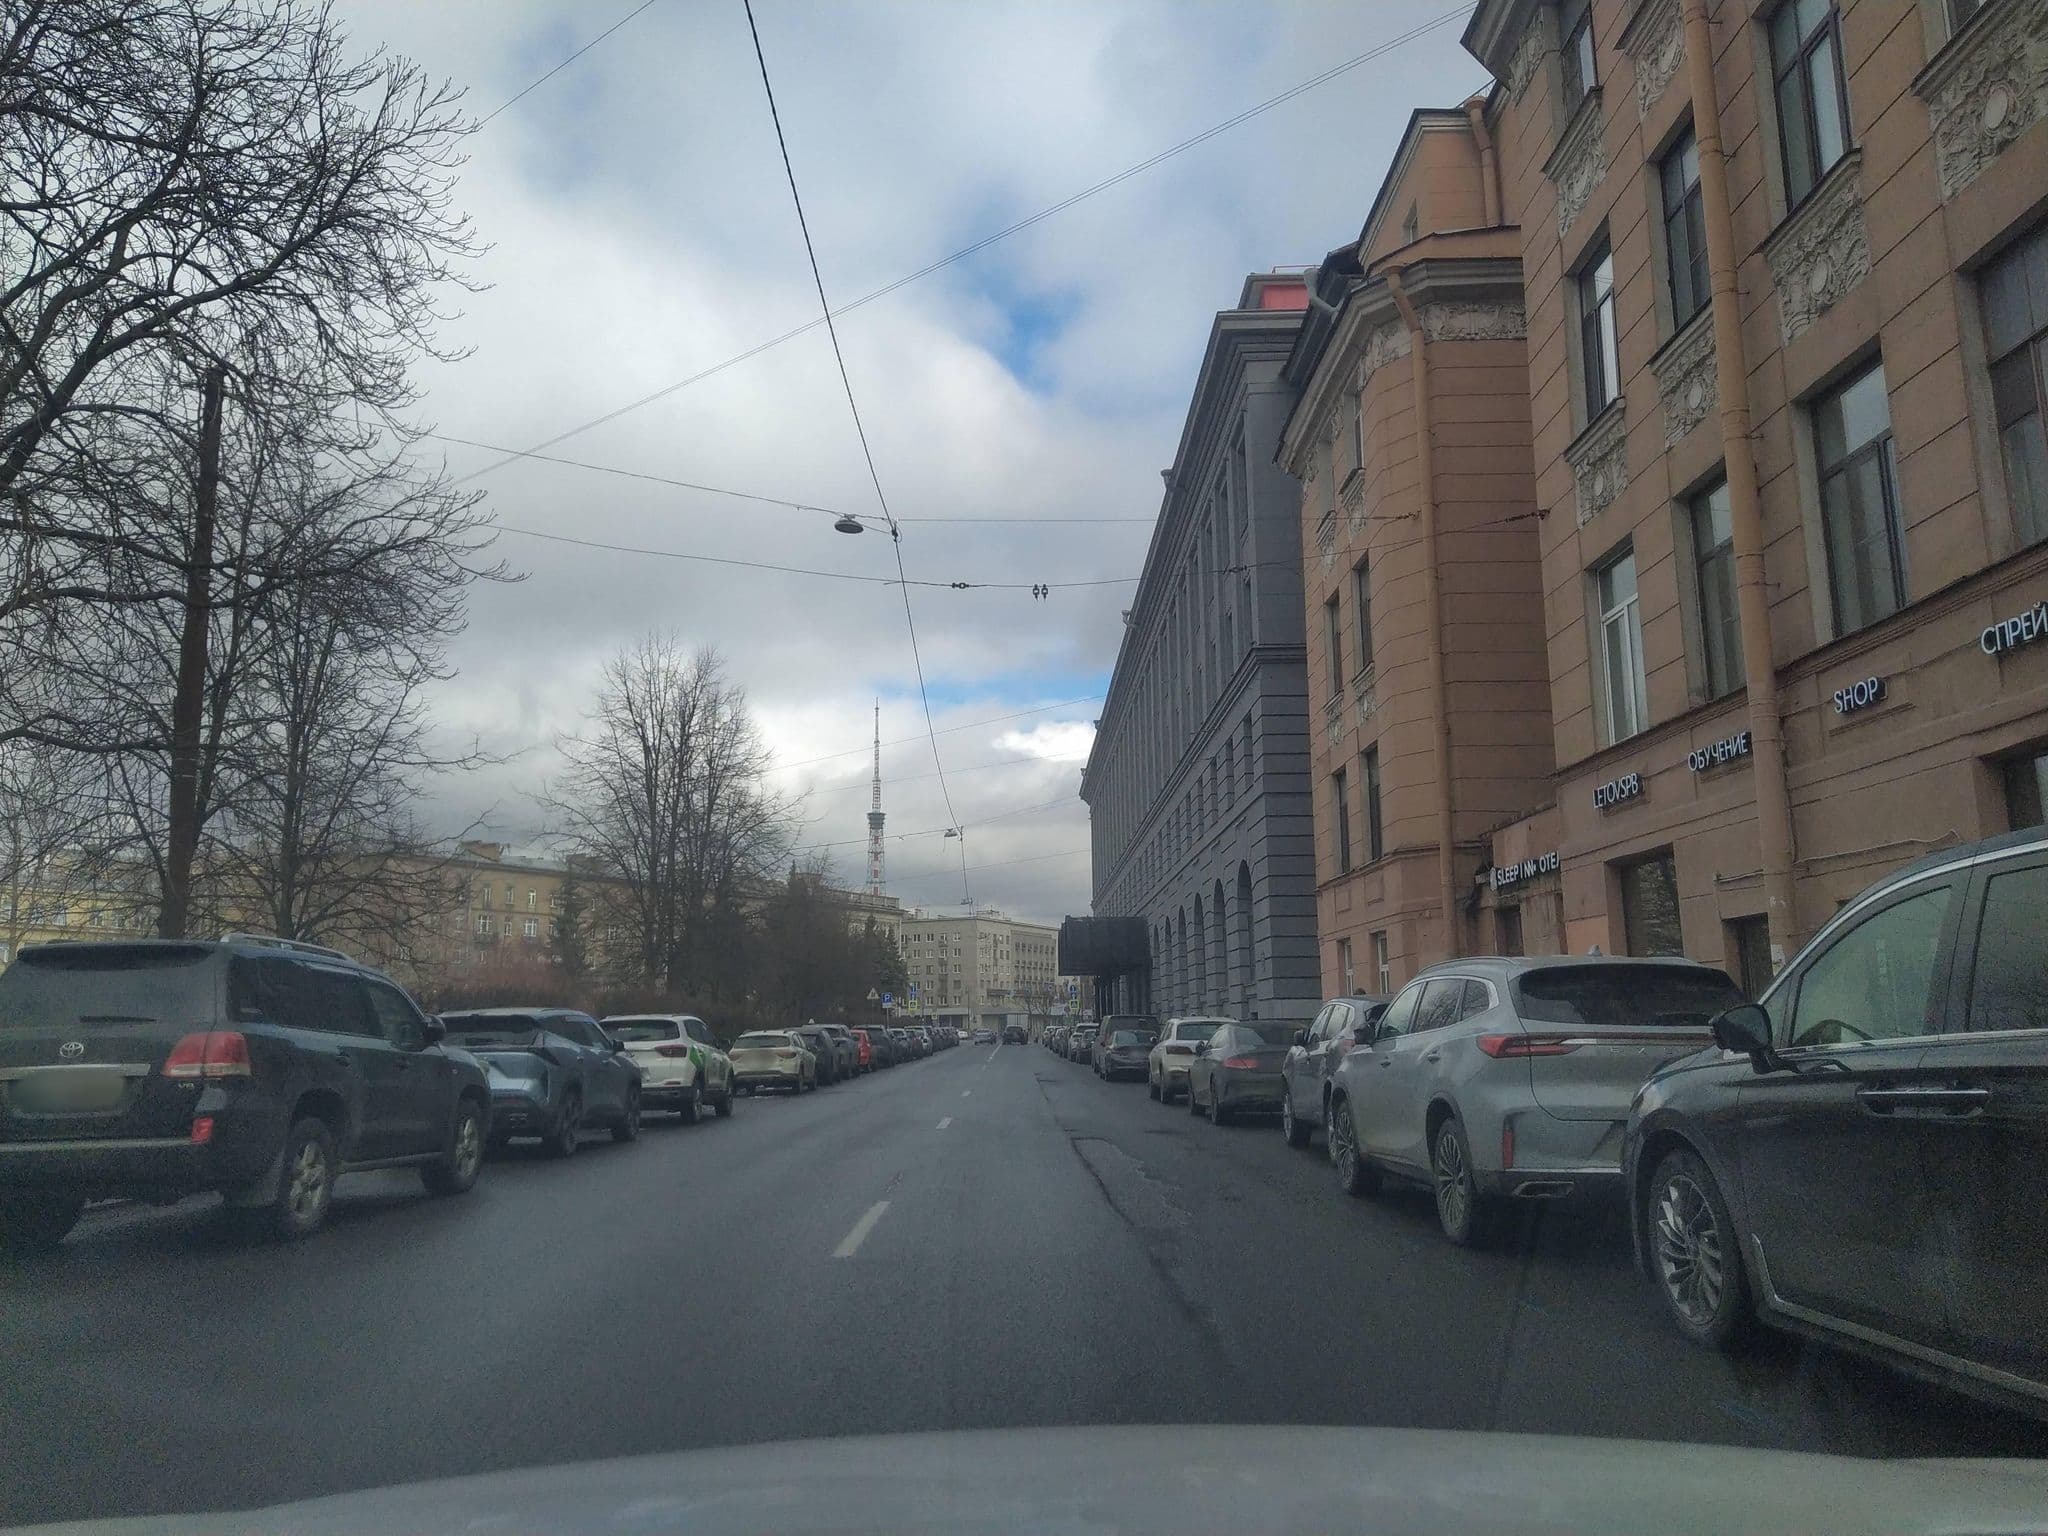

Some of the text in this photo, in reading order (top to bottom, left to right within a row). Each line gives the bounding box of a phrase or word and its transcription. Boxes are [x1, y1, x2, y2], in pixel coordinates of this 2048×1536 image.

[1980, 602, 2048, 655] СПРЕЙ
[1833, 676, 1878, 714] SHOP
[1687, 732, 1749, 772] ОБУЧЕНИЕ
[1592, 772, 1639, 809] LETOVSPB
[1497, 864, 1519, 886] SLEEP
